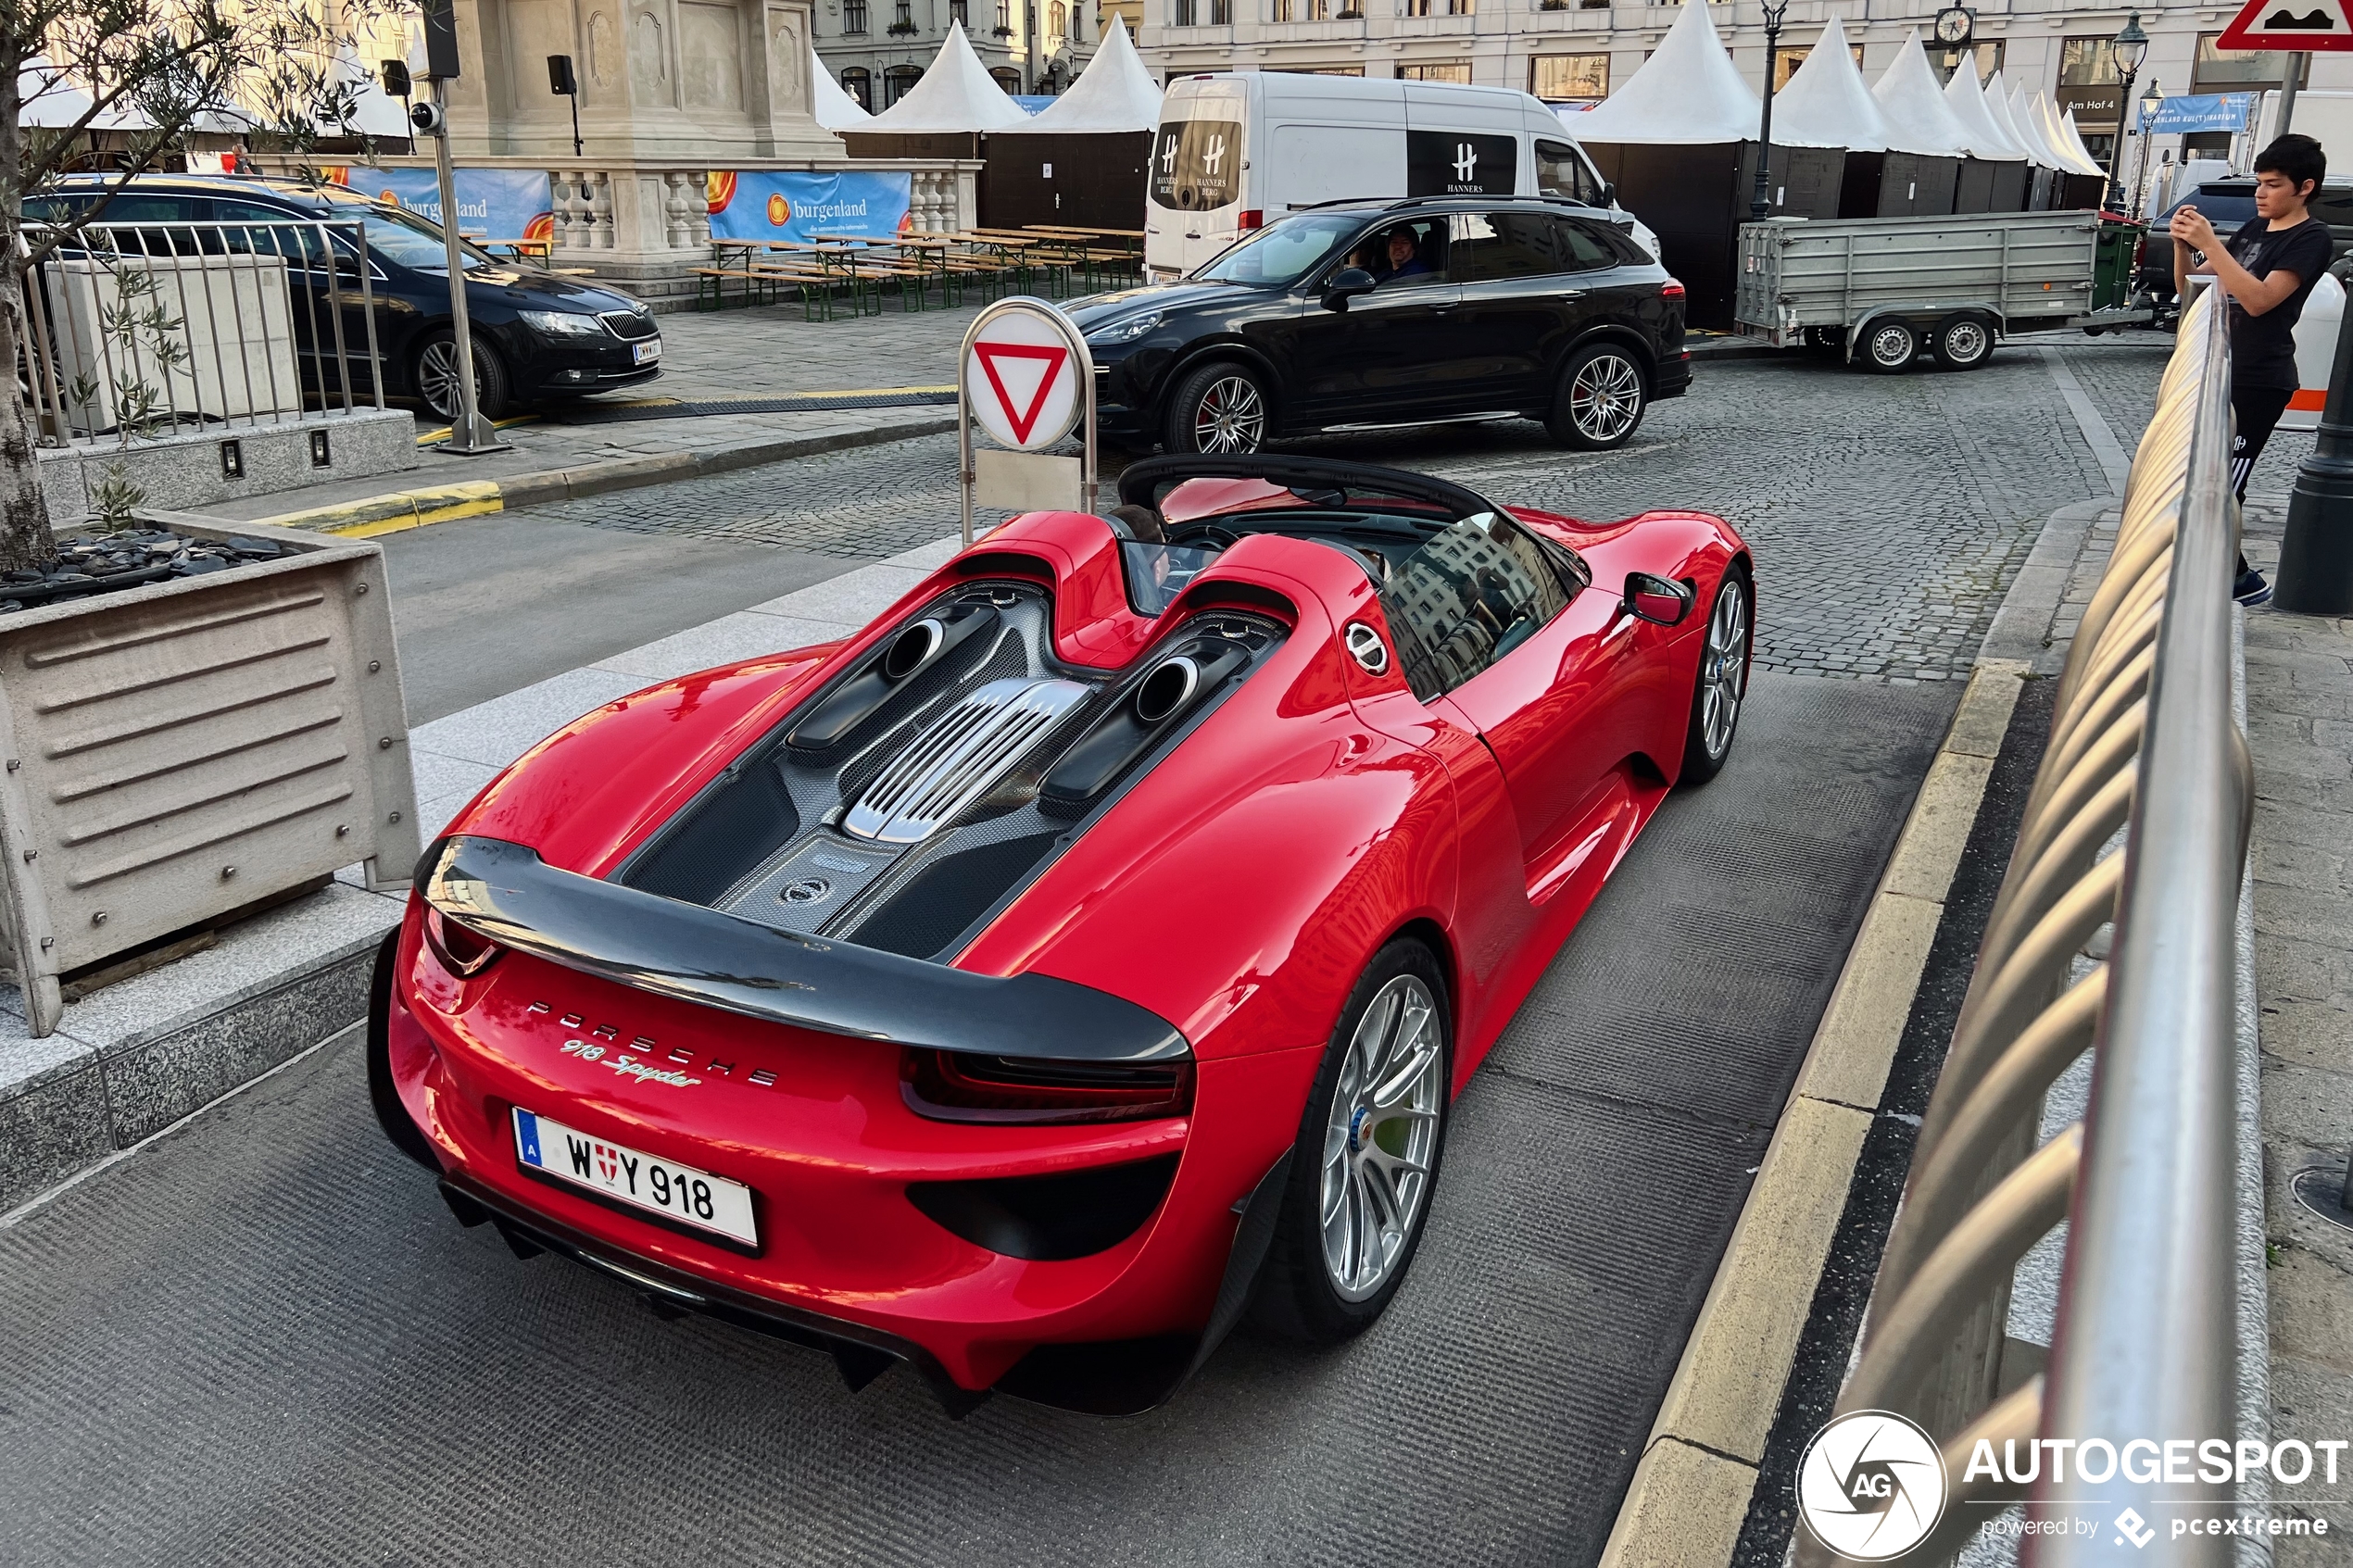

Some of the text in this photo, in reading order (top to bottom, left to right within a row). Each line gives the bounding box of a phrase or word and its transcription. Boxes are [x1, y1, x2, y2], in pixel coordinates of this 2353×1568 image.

[2067, 100, 2114, 109] Am Hof 4
[1157, 176, 1178, 184] HANNERS
[1197, 178, 1227, 187] HANNERS
[1202, 188, 1218, 196] BERG
[1447, 183, 1483, 193] HANNERS
[793, 198, 867, 222] burgenland
[527, 1001, 778, 1086] PORSCHE
[560, 1038, 701, 1087] 918 Spyder
[527, 1143, 537, 1158] A
[566, 1133, 591, 1179] W
